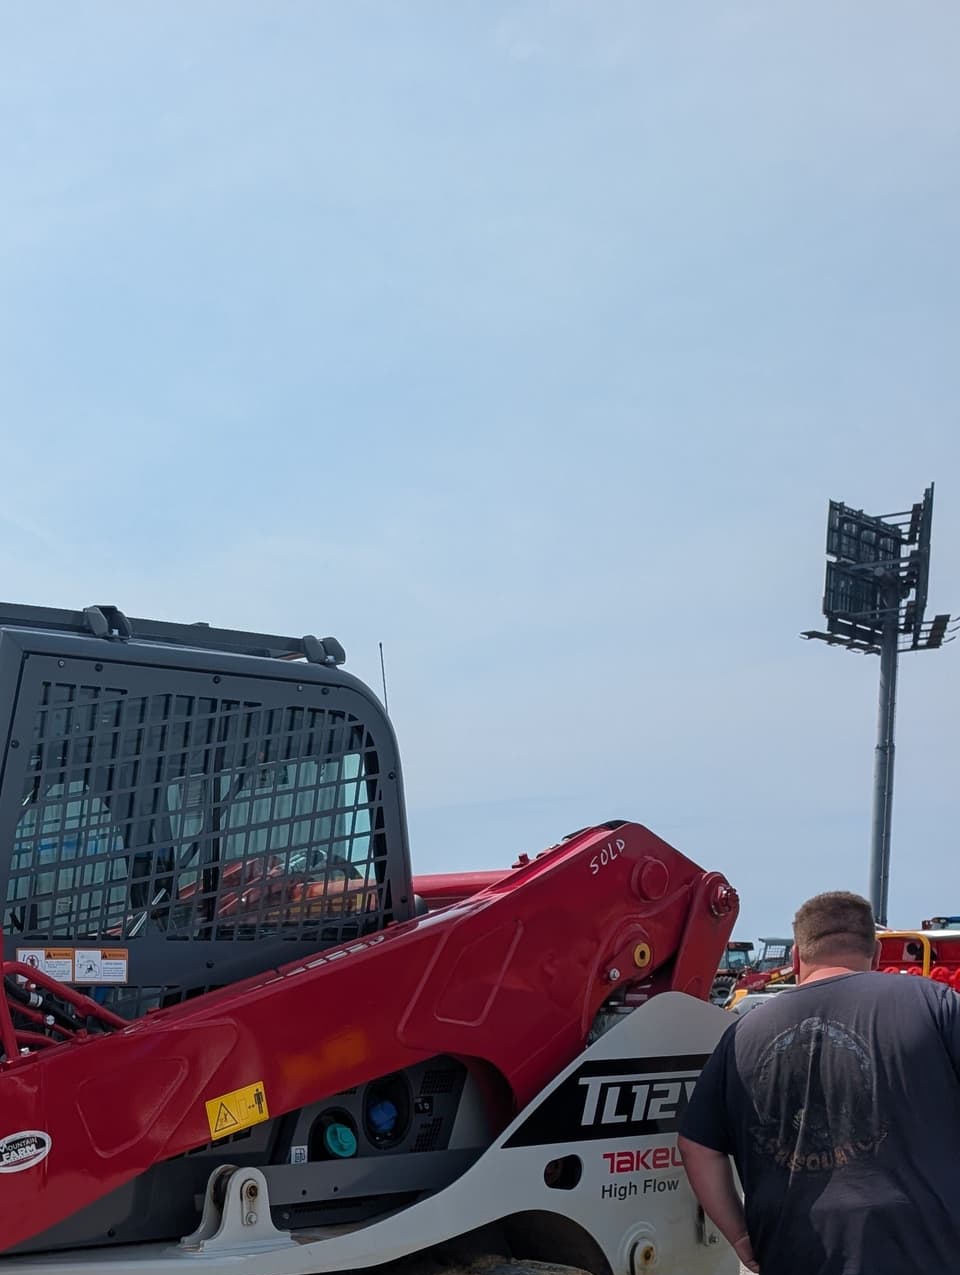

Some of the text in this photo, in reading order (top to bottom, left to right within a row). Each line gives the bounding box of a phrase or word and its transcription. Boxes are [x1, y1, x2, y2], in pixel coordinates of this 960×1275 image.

[590, 839, 625, 875] SOLD
[2, 1144, 37, 1162] FARM
[602, 1147, 684, 1174] TAKEU
[601, 1179, 679, 1200] High Flow
